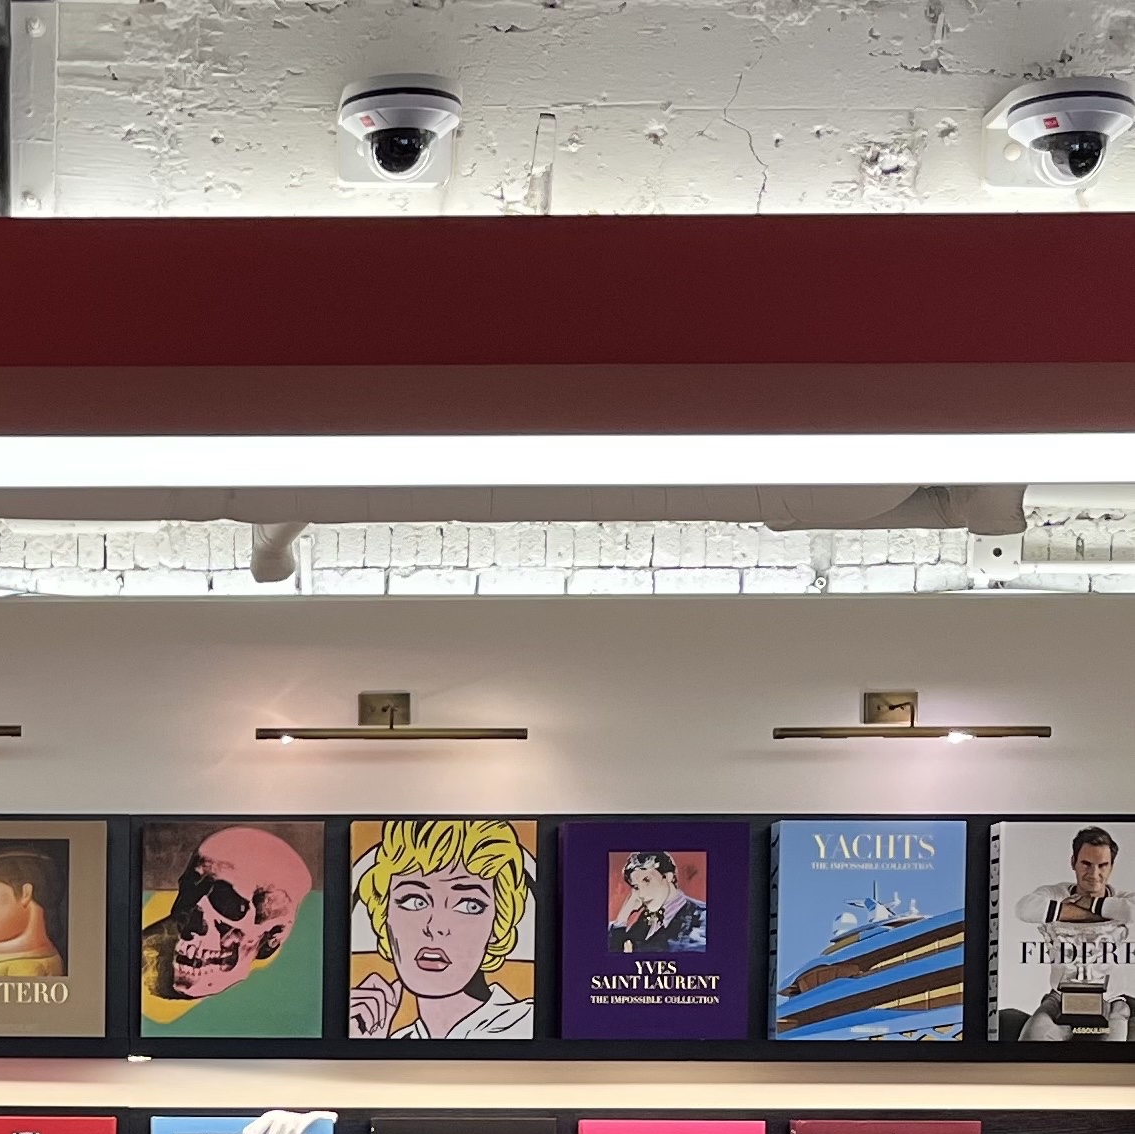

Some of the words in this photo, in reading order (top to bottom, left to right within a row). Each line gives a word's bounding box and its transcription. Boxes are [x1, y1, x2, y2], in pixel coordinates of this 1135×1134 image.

[813, 833, 936, 859] YACHTS
[635, 960, 677, 975] YVES
[591, 975, 641, 990] SAINT
[643, 975, 721, 990] LAURENT
[590, 994, 609, 1004] THE
[610, 994, 663, 1004] IMPOSSIBLE
[664, 994, 721, 1004] COLLECTION
